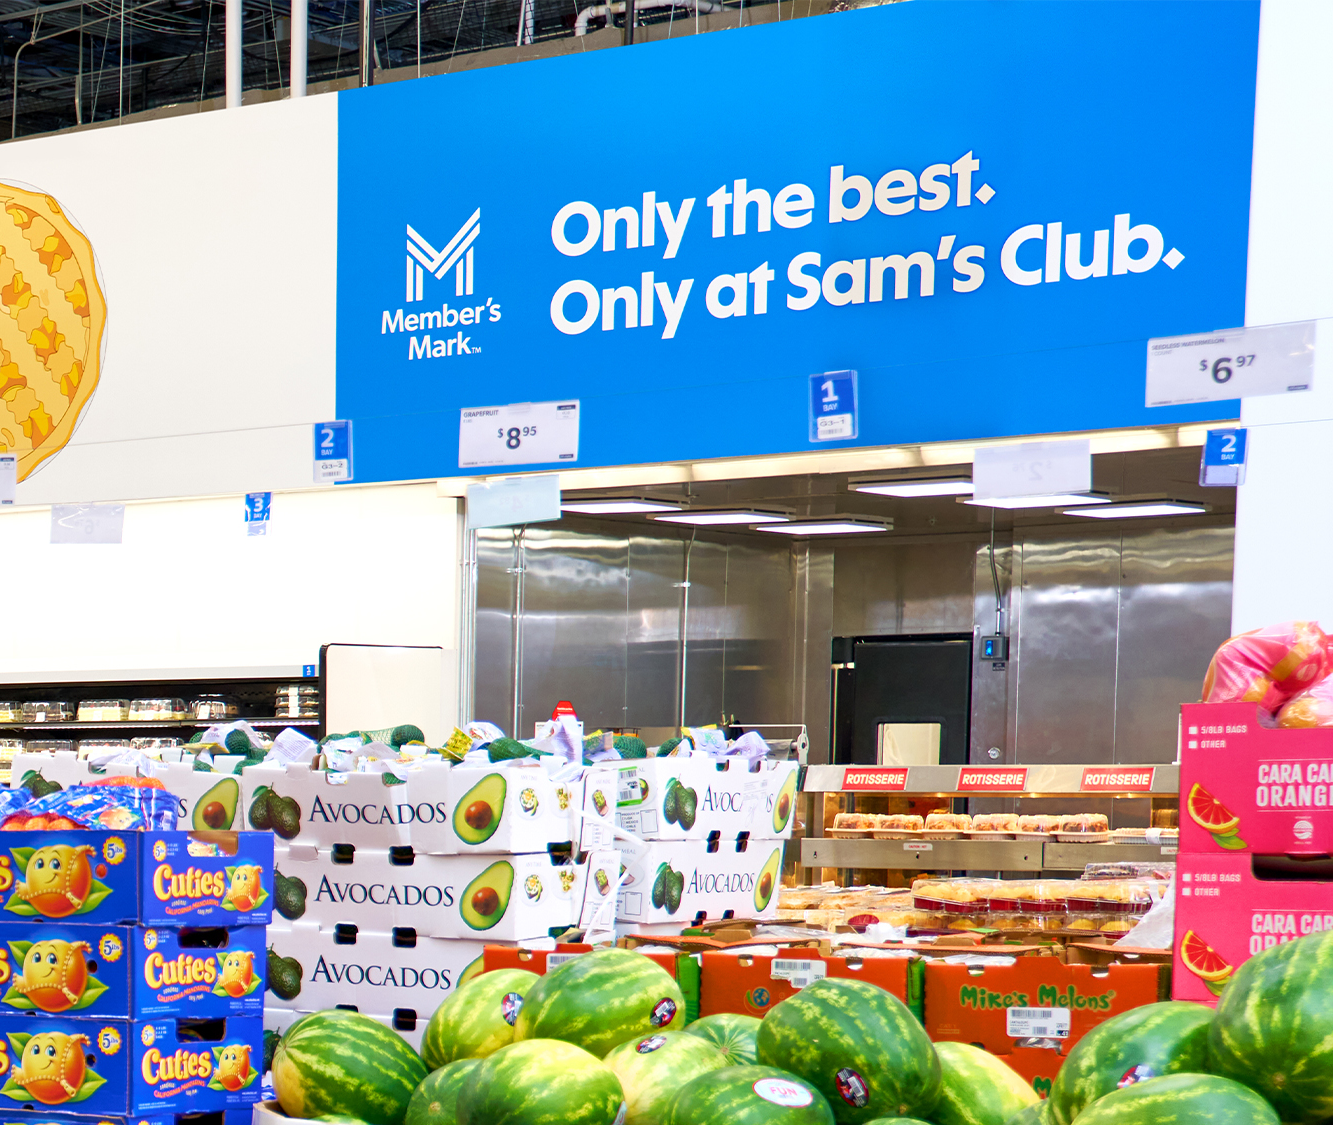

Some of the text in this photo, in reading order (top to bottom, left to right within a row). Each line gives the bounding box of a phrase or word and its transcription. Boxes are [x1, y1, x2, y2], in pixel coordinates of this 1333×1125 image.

[551, 150, 997, 259] Only the best.
[550, 213, 1186, 340] Only at Sam's Club.
[381, 297, 502, 334] Member's
[821, 380, 839, 403] 1
[463, 409, 499, 418] GRAPEFRUIT
[823, 403, 838, 412] BAY
[320, 428, 334, 448] 2
[1220, 434, 1236, 453] 2
[253, 498, 264, 513] 3
[1200, 725, 1247, 735] 5/8LB BAGS
[1200, 740, 1226, 749] OTHER
[845, 772, 905, 785] ROTISSERIE
[961, 772, 1024, 786] ROTISSERIE
[1084, 772, 1151, 786] ROTISSERIE
[1257, 763, 1302, 784] CARA
[308, 795, 447, 825] AVOCADOS
[152, 863, 225, 902] Cuties
[686, 866, 755, 894] AVOCADOS
[1194, 873, 1241, 882] 5/8LB BAGS
[314, 880, 455, 910] AVOCADOS
[1194, 887, 1220, 897] OTHER
[1251, 913, 1296, 934] CARA
[143, 951, 216, 989] Cuties
[310, 954, 452, 990] AVOCADOS
[959, 983, 1029, 1010] Mike's
[769, 1086, 798, 1096] FUN
